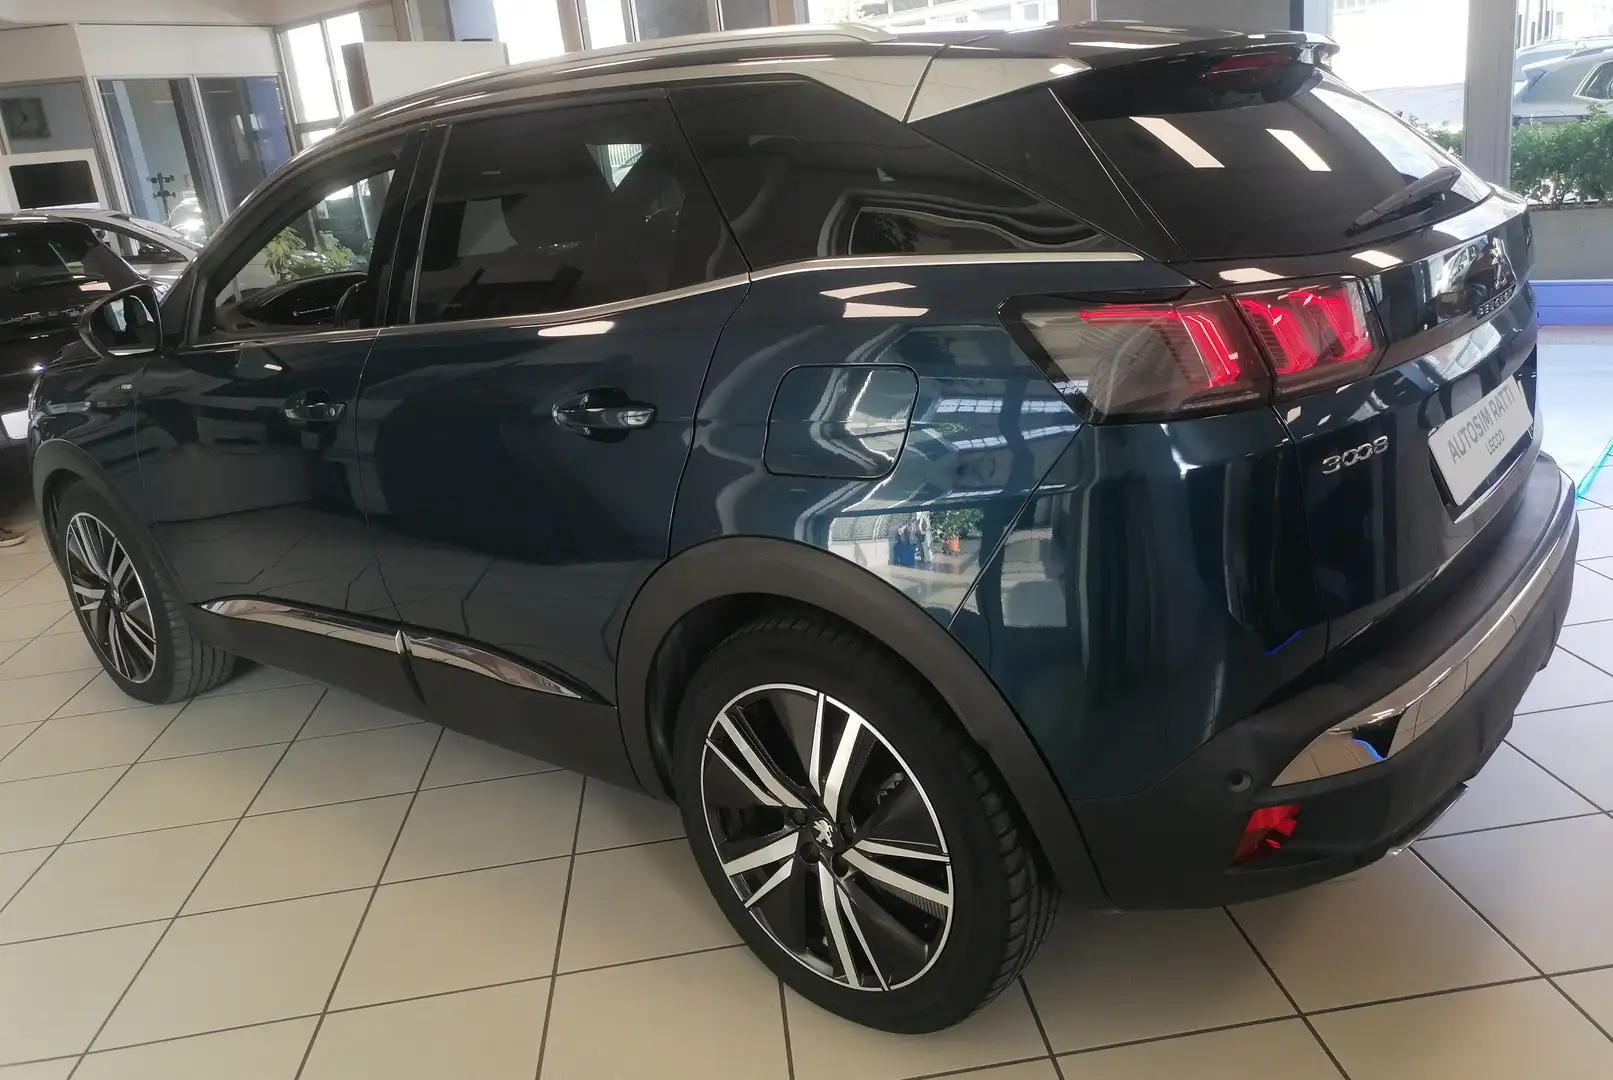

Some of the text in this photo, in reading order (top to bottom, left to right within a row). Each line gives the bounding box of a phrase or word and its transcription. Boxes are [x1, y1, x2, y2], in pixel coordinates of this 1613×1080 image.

[1447, 384, 1516, 464] AUTOSIM RATTI
[1484, 428, 1506, 456] LECCO
[1322, 435, 1389, 475] 3008
